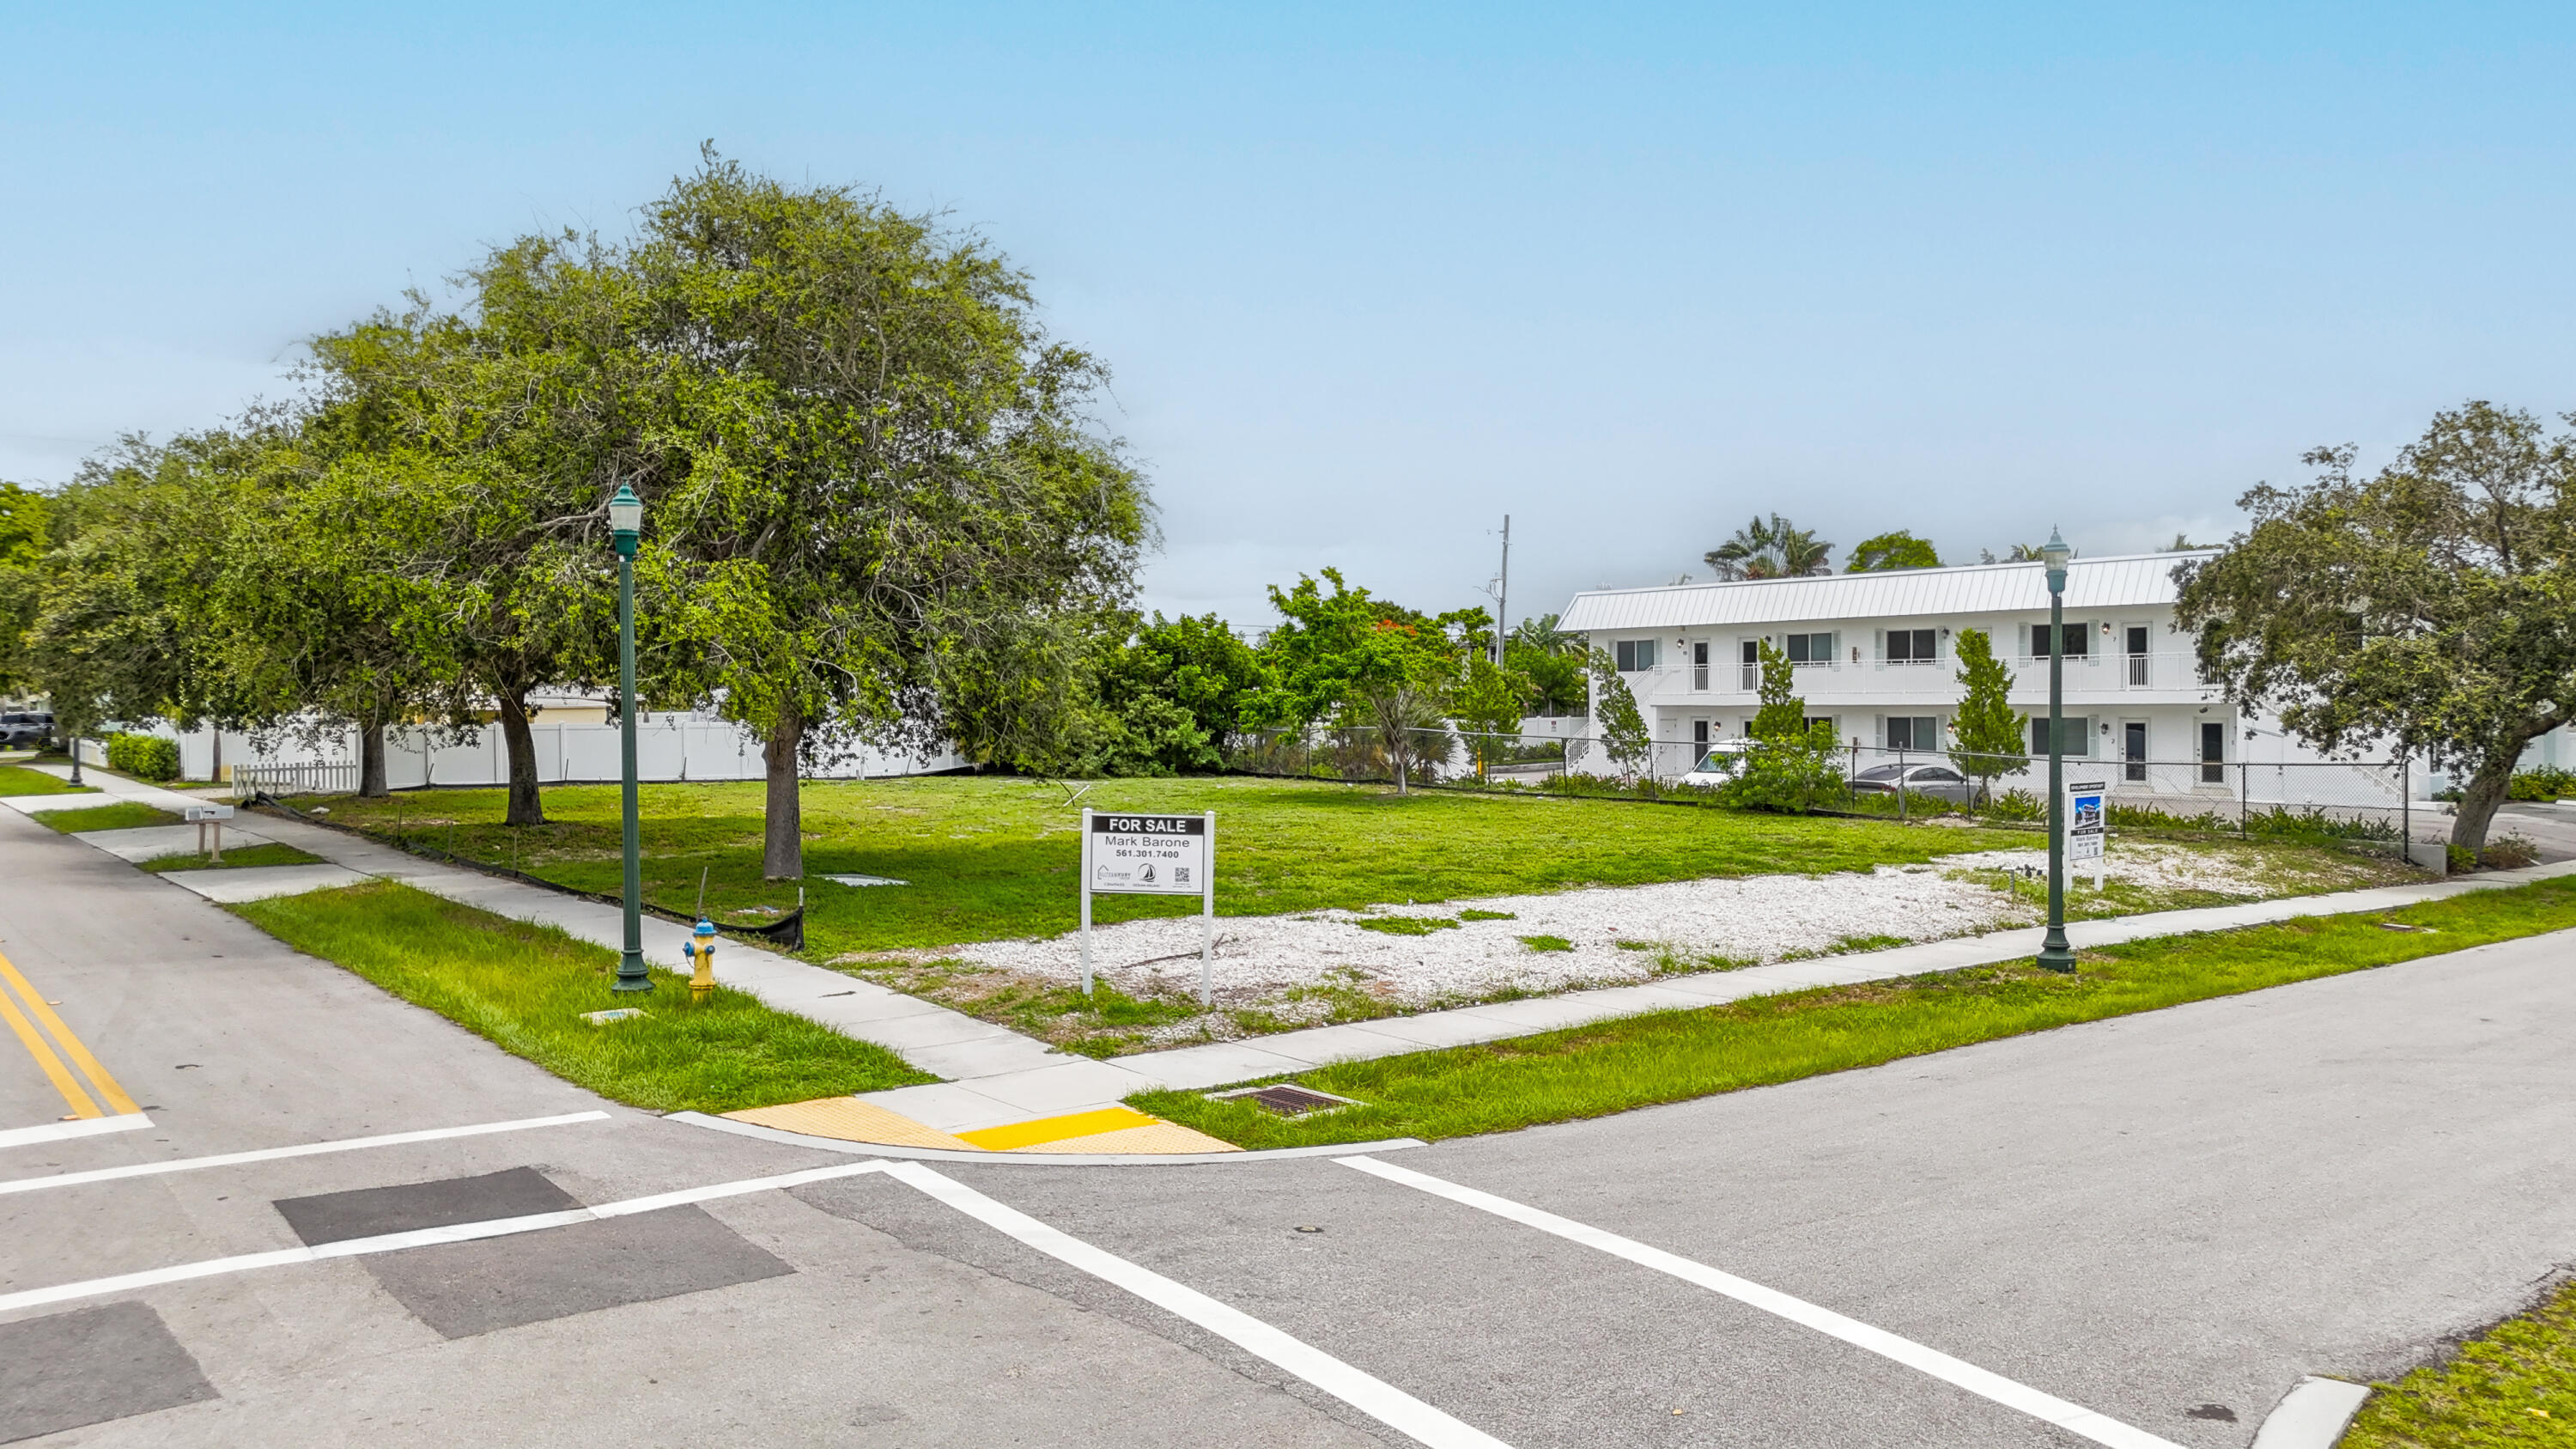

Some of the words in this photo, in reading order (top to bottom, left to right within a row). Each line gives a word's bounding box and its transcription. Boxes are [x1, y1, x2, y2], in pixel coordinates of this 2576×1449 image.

[1109, 819, 1141, 831] FOR
[1145, 819, 1187, 832] SALE
[1105, 835, 1138, 846] Mark
[1143, 837, 1190, 848] Barone
[1115, 849, 1179, 858] 561.301.7400
